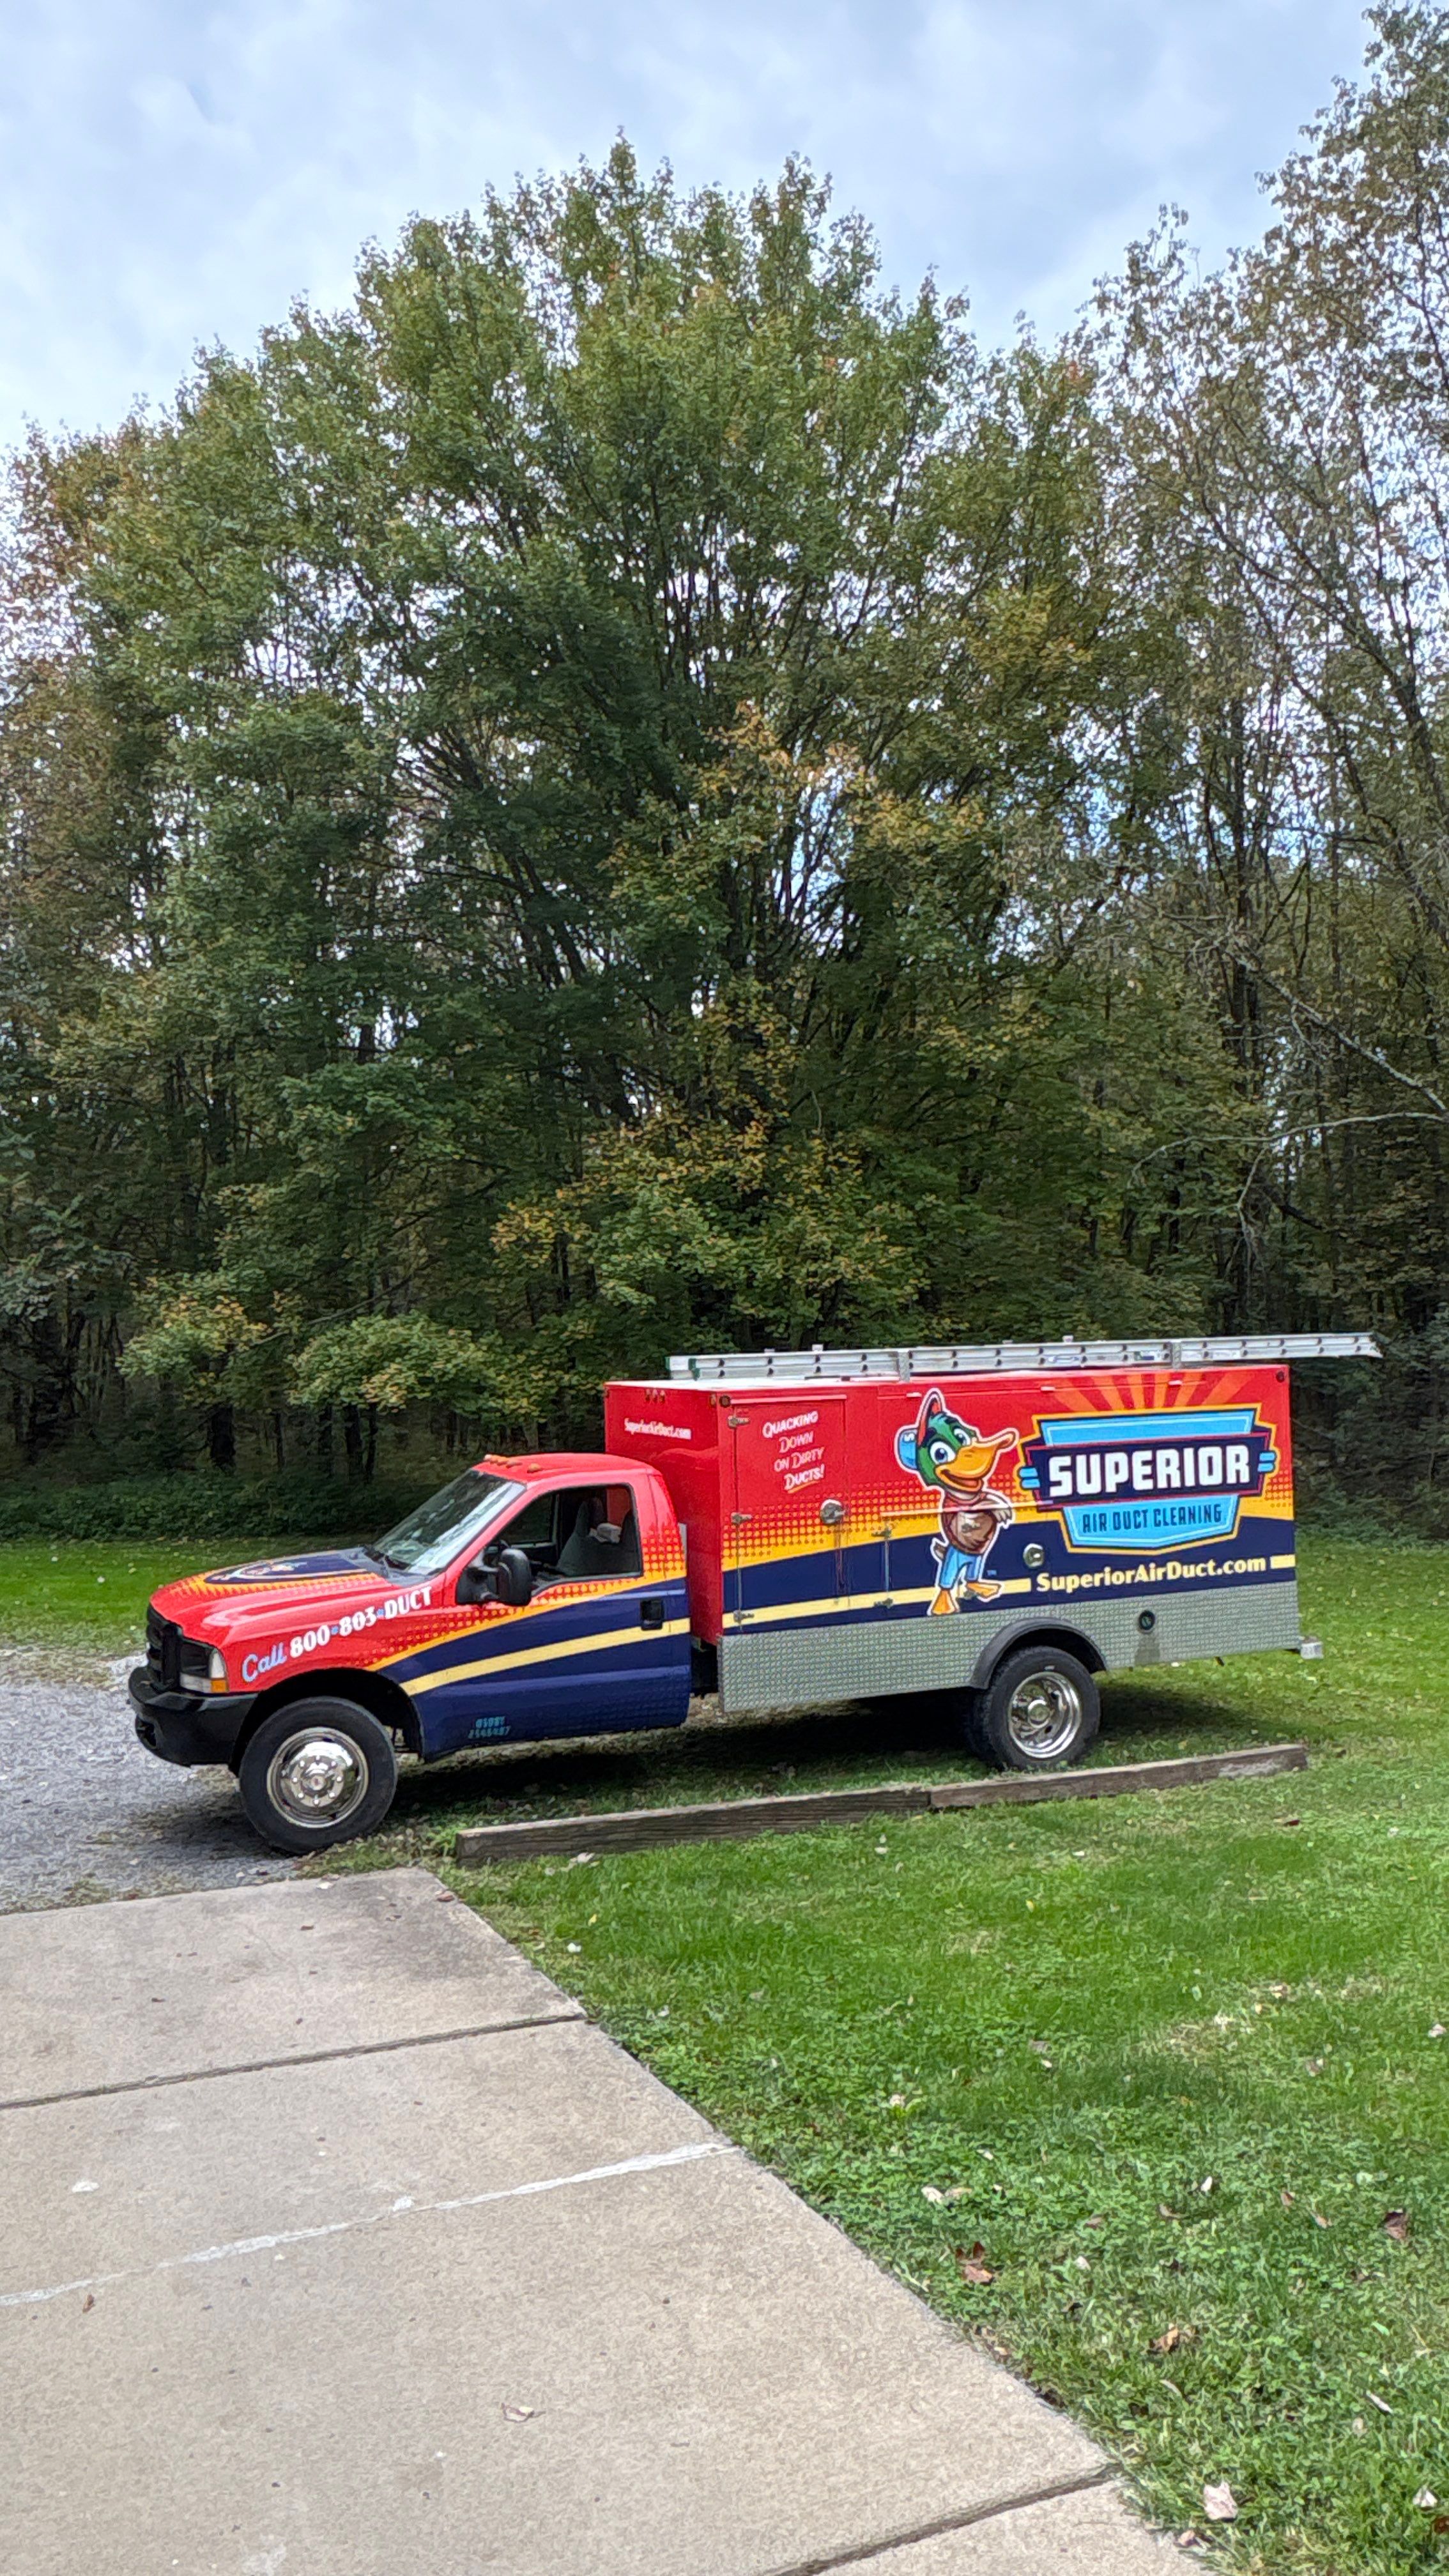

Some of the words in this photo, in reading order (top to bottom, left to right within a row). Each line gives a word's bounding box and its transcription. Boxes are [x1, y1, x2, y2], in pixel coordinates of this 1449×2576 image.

[762, 1411, 818, 1438] QUACKING
[779, 1431, 814, 1453] DOWN
[774, 1457, 790, 1472] ON
[791, 1446, 825, 1468] DIRTY
[1048, 1445, 1250, 1497] SUPERIOR
[784, 1463, 825, 1491] DUCTS!
[1082, 1513, 1107, 1533] AIR
[1112, 1509, 1149, 1531] DUCT
[1153, 1503, 1222, 1528] CLEANING
[1036, 1556, 1266, 1593] SuperiorAirDuct.com
[241, 1642, 288, 1683] Call
